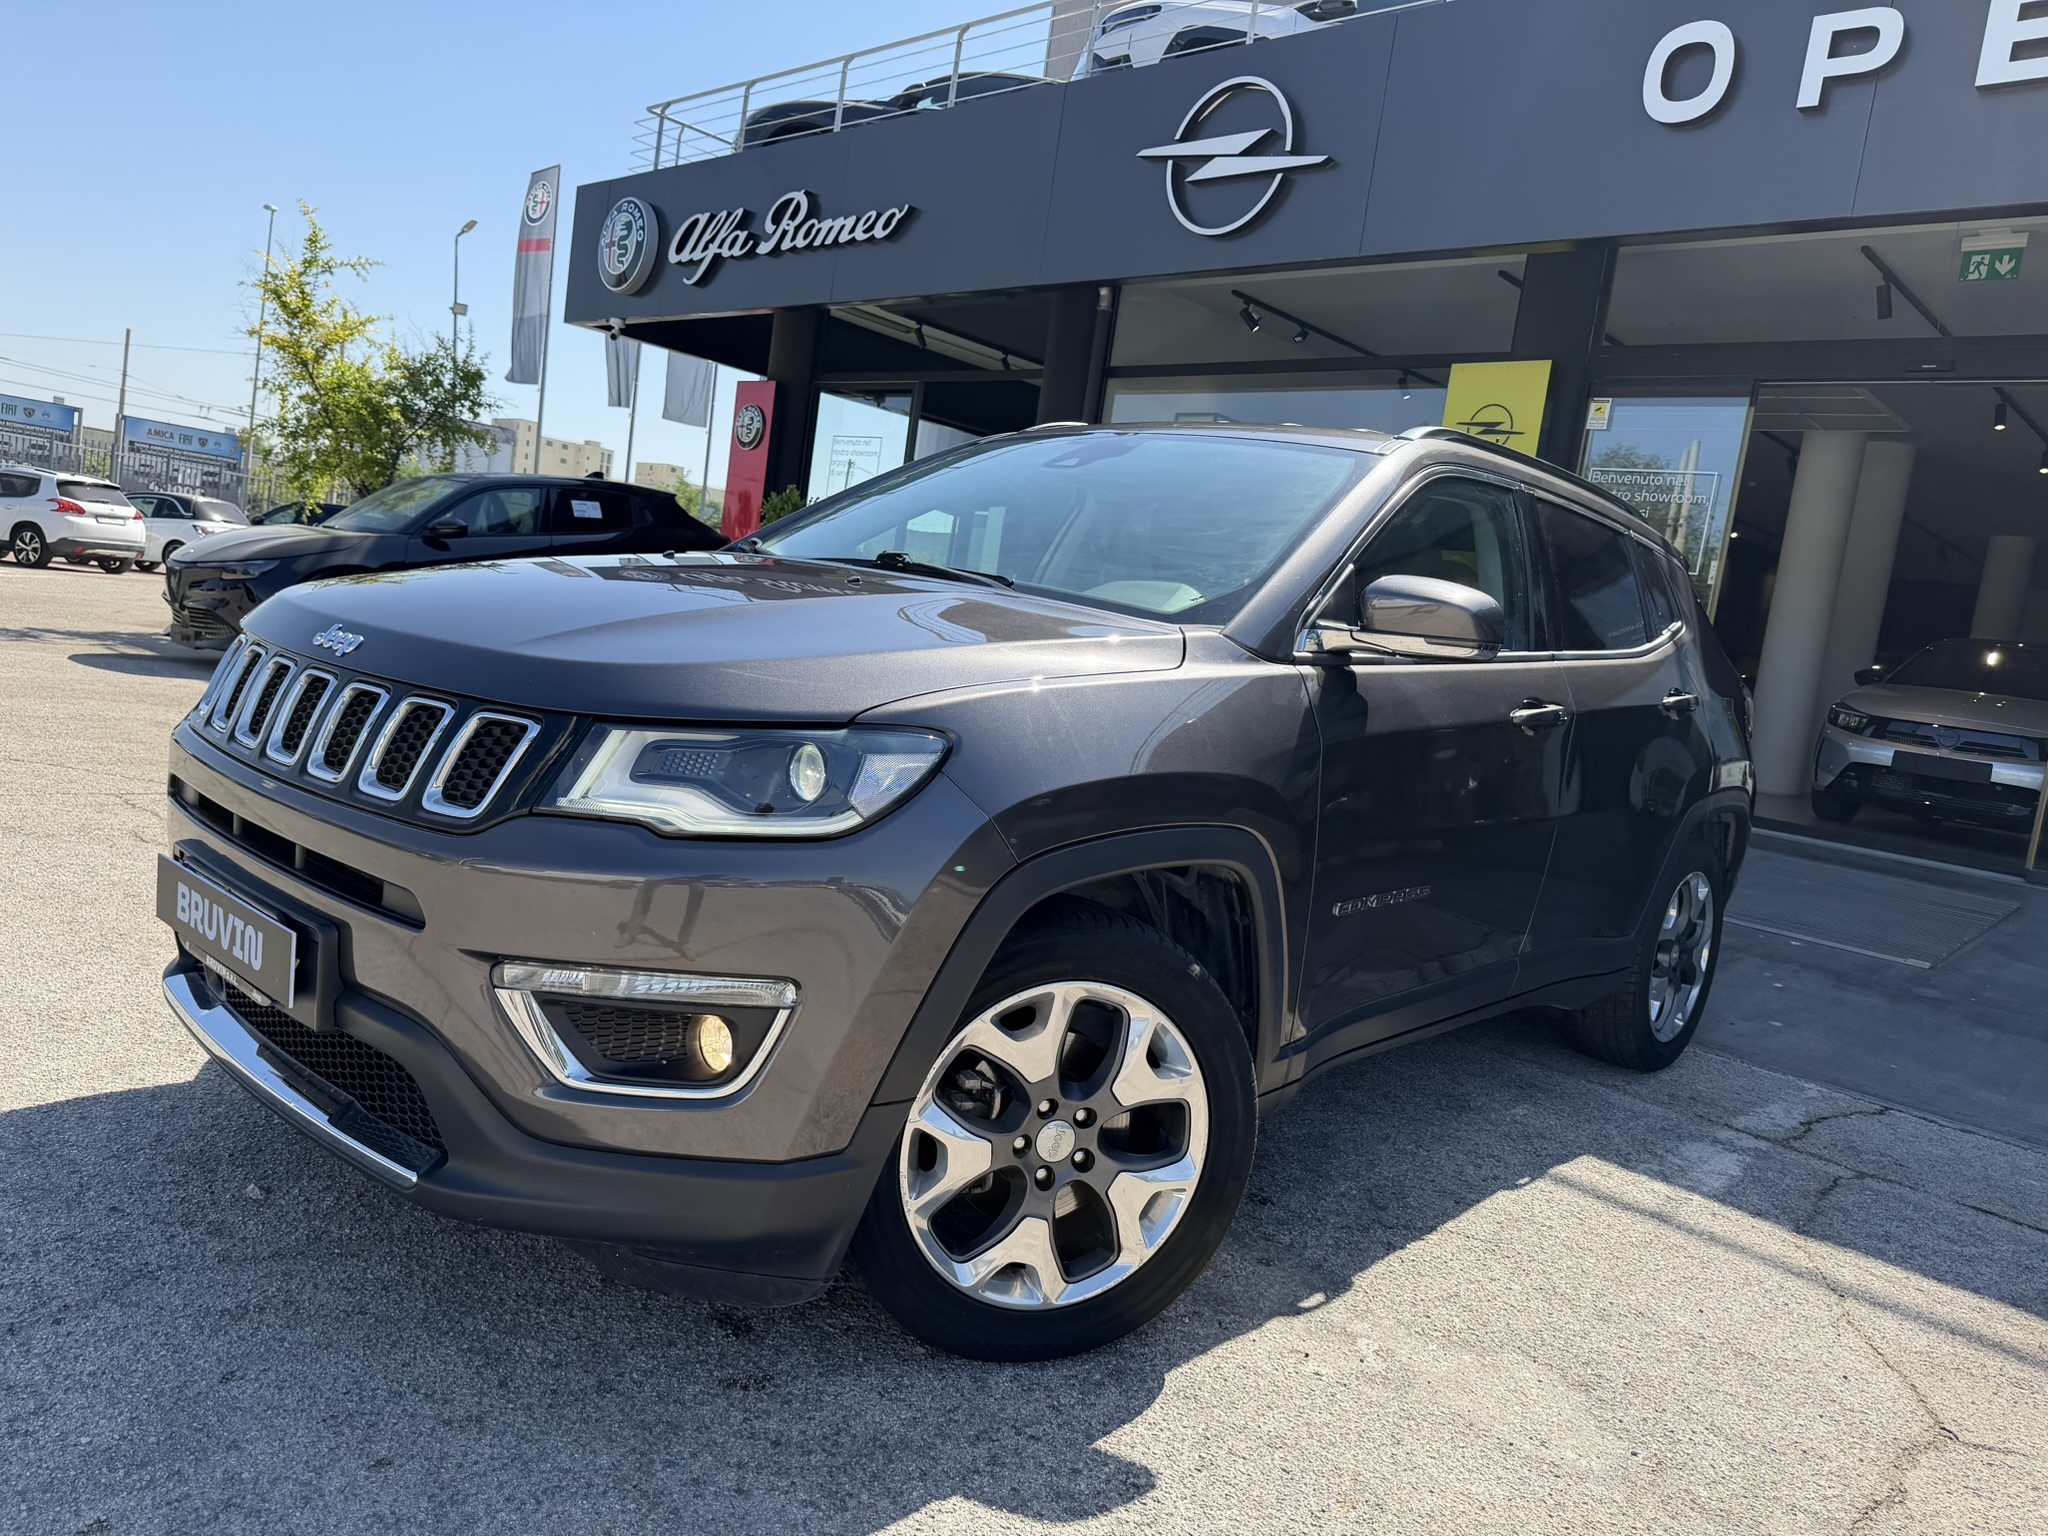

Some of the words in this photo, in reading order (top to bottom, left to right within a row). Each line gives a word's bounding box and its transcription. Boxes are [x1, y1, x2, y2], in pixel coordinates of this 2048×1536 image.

[620, 202, 645, 242] ROMEO
[668, 206, 754, 286] Alfa
[755, 188, 910, 256] Romeo
[1, 403, 18, 416] FIAT
[146, 427, 175, 441] AMICA
[178, 433, 194, 446] FIAT
[1592, 470, 1663, 486] Benvenuto
[1666, 474, 1688, 487] nel
[1633, 489, 1710, 506] showroom,
[312, 623, 365, 657] Jeep
[177, 882, 263, 971] BRUVIN
[1048, 1125, 1066, 1159] Jeep
